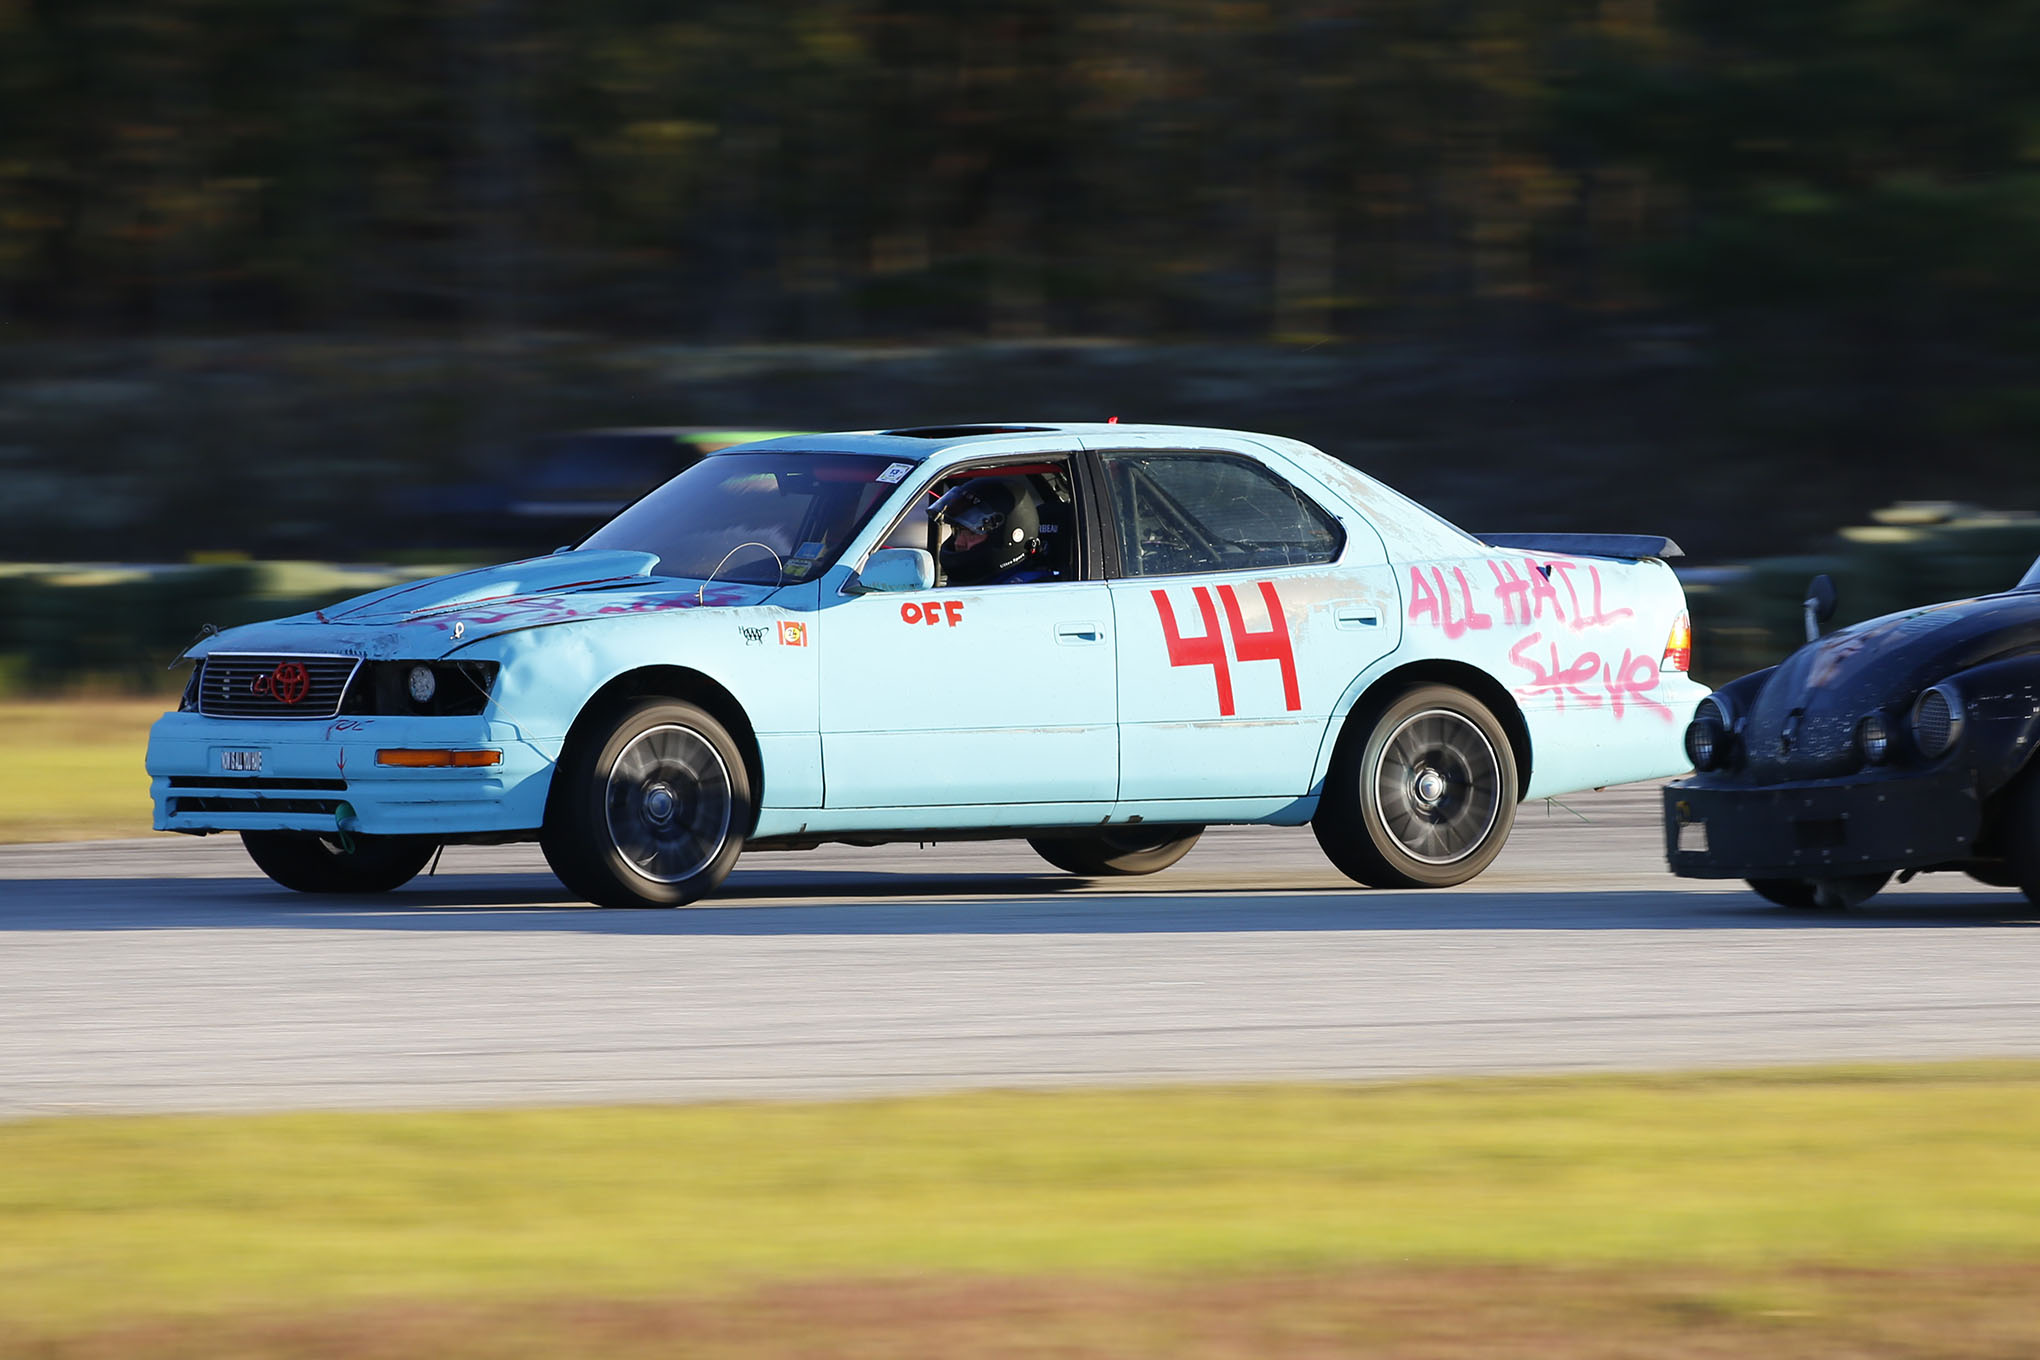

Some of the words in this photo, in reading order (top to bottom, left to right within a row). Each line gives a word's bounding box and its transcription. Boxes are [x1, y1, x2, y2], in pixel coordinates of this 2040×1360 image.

[900, 600, 964, 628] OFF
[1408, 564, 1493, 639] ALL
[1487, 557, 1634, 632] HAIL
[1150, 581, 1302, 717] 44
[1508, 631, 1674, 724] Steve
